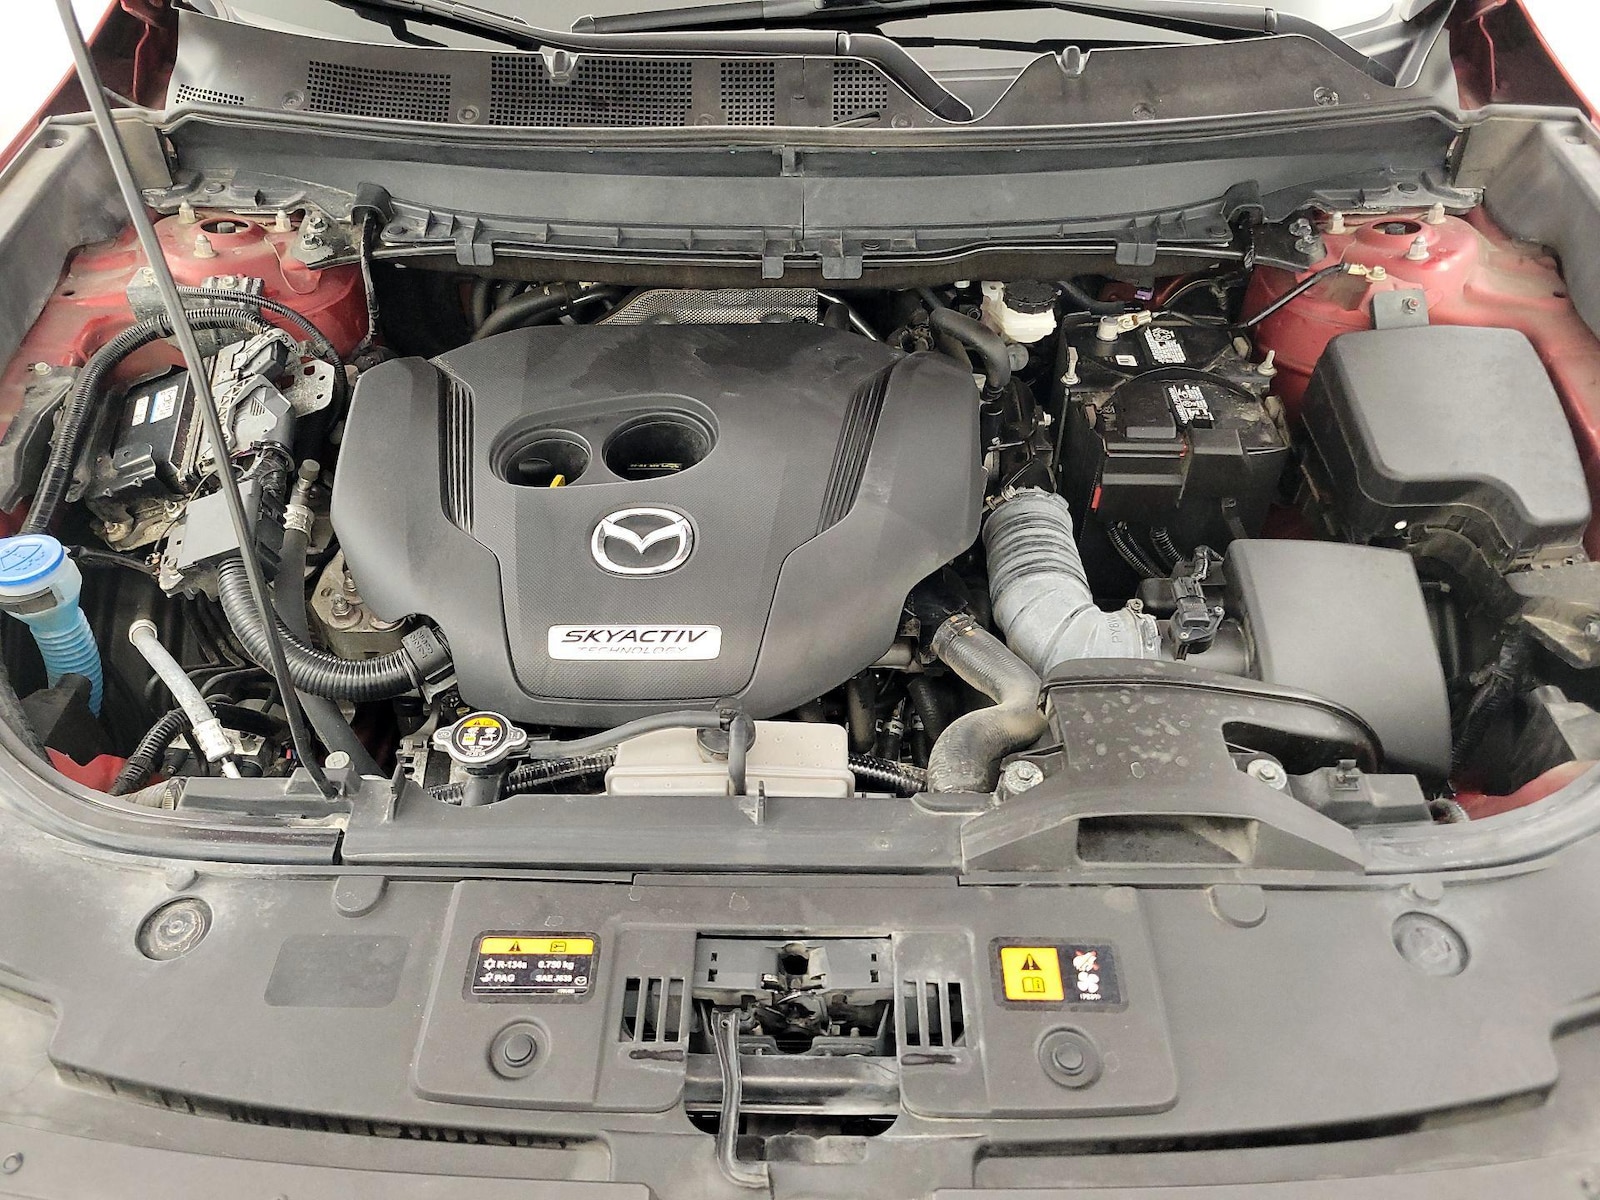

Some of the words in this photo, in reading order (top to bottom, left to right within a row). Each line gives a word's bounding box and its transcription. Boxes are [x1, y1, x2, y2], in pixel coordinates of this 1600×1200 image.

[561, 629, 709, 643] SKYACTIV
[577, 646, 688, 655] TECHNOLOGY
[496, 960, 527, 969] R-134a
[562, 960, 575, 971] kg
[493, 974, 516, 982] PAG
[535, 974, 553, 982] SAE
